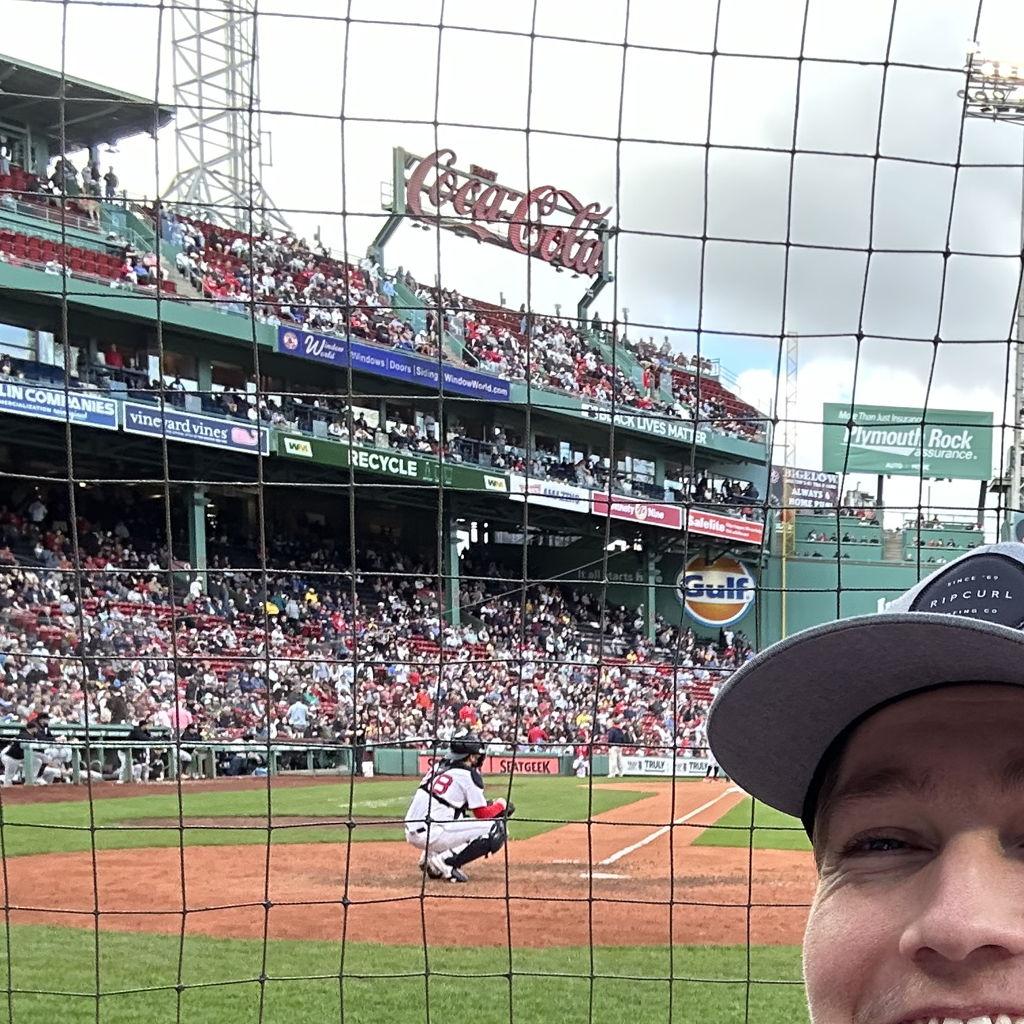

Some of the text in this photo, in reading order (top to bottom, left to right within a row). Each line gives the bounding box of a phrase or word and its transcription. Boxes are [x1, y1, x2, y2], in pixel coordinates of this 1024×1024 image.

[406, 148, 613, 276] Coca-Cola
[351, 350, 508, 397] Windows Doors Siding WindowWorld.com
[24, 388, 115, 416] COMPANIES
[129, 411, 190, 434] vineard
[192, 421, 229, 440] vines
[598, 407, 707, 444] BLACK LIVES MATTER
[891, 413, 925, 423] Insuranc
[843, 425, 974, 450] Plymouth Rock
[347, 449, 418, 477] RECYCLE
[687, 514, 726, 533] Safelite
[682, 574, 750, 600] Gulf
[946, 575, 976, 587] SINCE
[499, 759, 552, 774] SEATGEEK
[644, 759, 666, 769] TRULY
